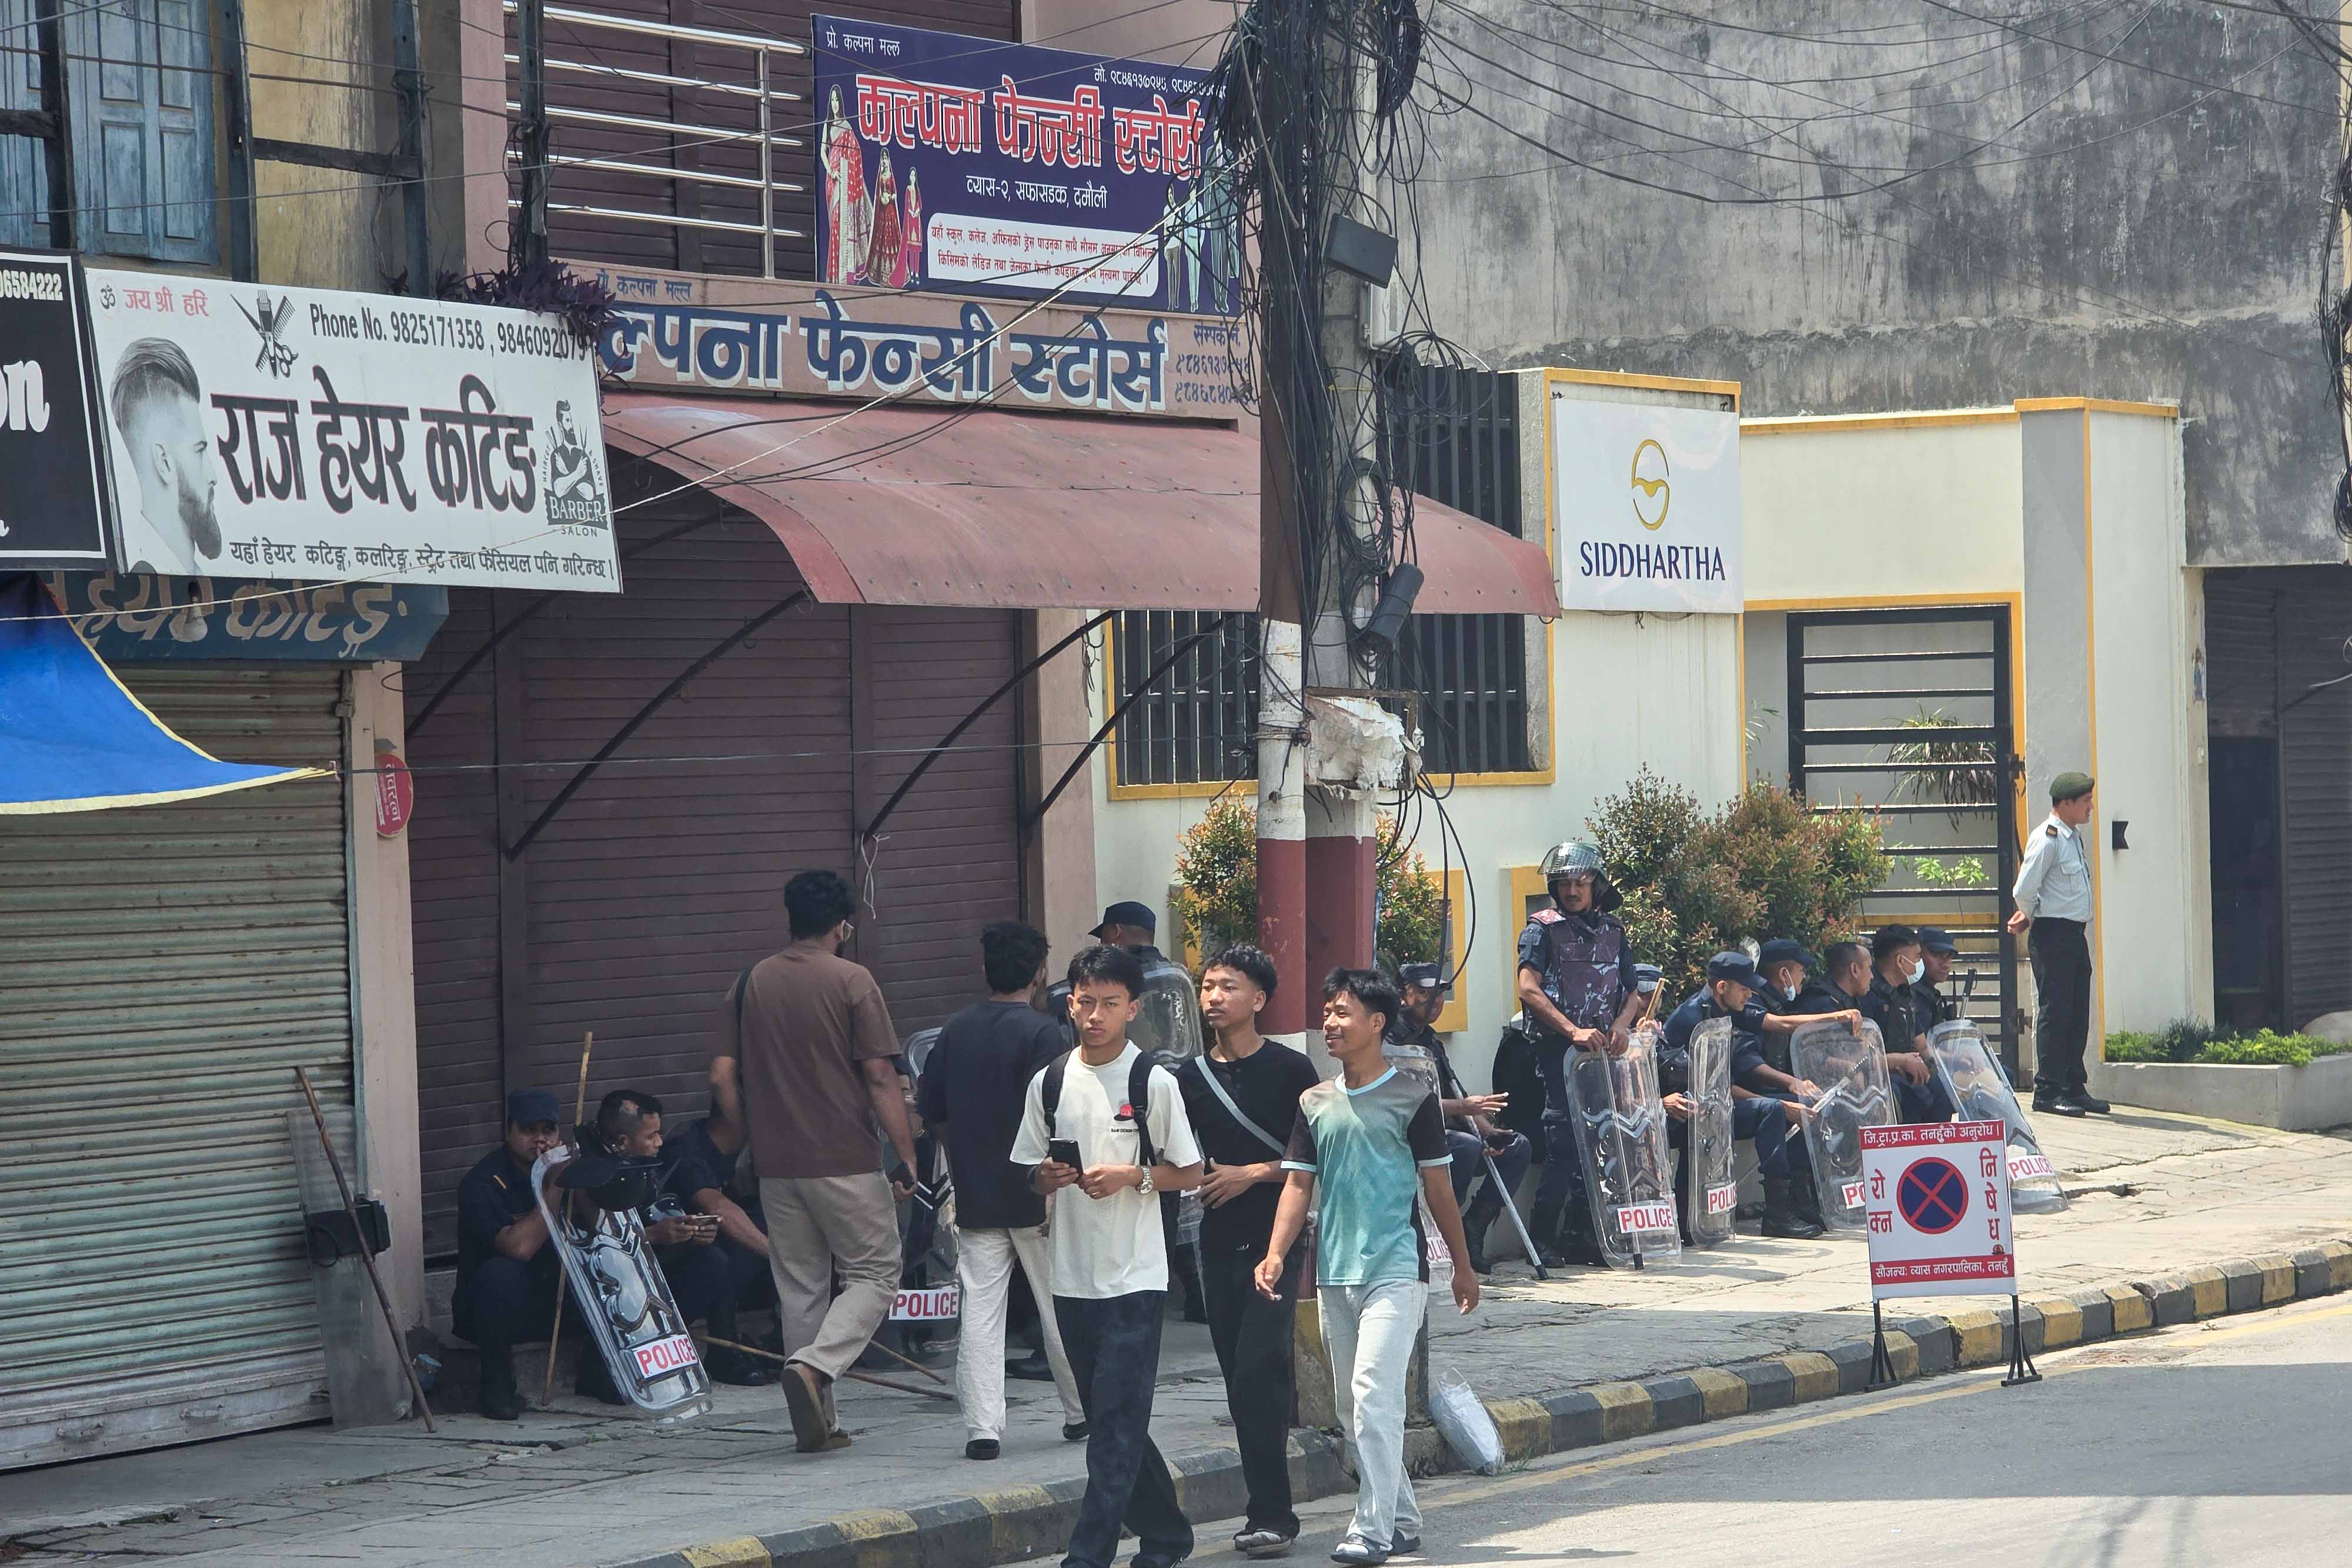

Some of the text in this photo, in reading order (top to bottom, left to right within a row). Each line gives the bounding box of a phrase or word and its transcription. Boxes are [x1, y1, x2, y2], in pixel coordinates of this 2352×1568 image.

[826, 25, 901, 57] प्रो. कल्पना मल्ल
[1093, 63, 1107, 83] मो.
[856, 73, 1207, 182] कल्पना फेन्सी स्टोर्स
[965, 175, 1108, 209] व्यास-२, सफासडक, दमौली
[931, 222, 944, 241] यहाँ
[968, 228, 988, 247] कलेज,
[992, 229, 1021, 248] अफिसको
[1024, 232, 1035, 252] ड्रेस
[1065, 235, 1078, 253] साथै
[1080, 236, 1098, 255] मौसम
[938, 249, 969, 268] किसिमको
[971, 252, 991, 270] लेडिज
[994, 258, 1007, 272] तथा
[122, 289, 152, 311] जय
[154, 285, 175, 313] श्री
[182, 289, 209, 317] हरि
[616, 276, 658, 298] कल्पना
[664, 280, 693, 303] मल्ल
[309, 303, 358, 339] Phone
[361, 306, 387, 342] No.
[390, 310, 485, 351] 9825171358
[596, 289, 1169, 412] ल्पना फेन्सी स्टोर्स
[210, 364, 537, 514] राज हेयर कटिङ
[549, 495, 604, 523] BARBER
[560, 525, 598, 537] SALON
[229, 536, 259, 565] यहाँ
[262, 537, 297, 565] हेयर
[415, 543, 446, 574] स्ट्रेट
[448, 550, 476, 570] तथा
[478, 546, 532, 573] फेसियल
[533, 550, 559, 575] पनि
[1580, 541, 1726, 581] SIDDHARTHA
[1920, 1124, 1957, 1144] तनहुँको
[1959, 1123, 1993, 1141] अनुरोध
[2008, 1156, 2053, 1179] POLICE
[1709, 1186, 1737, 1212] POLIC
[1621, 1207, 1673, 1232] POLICE
[1909, 1264, 1930, 1276] व्यास
[891, 1293, 958, 1318] POLICE
[636, 1337, 697, 1379] POLICE
